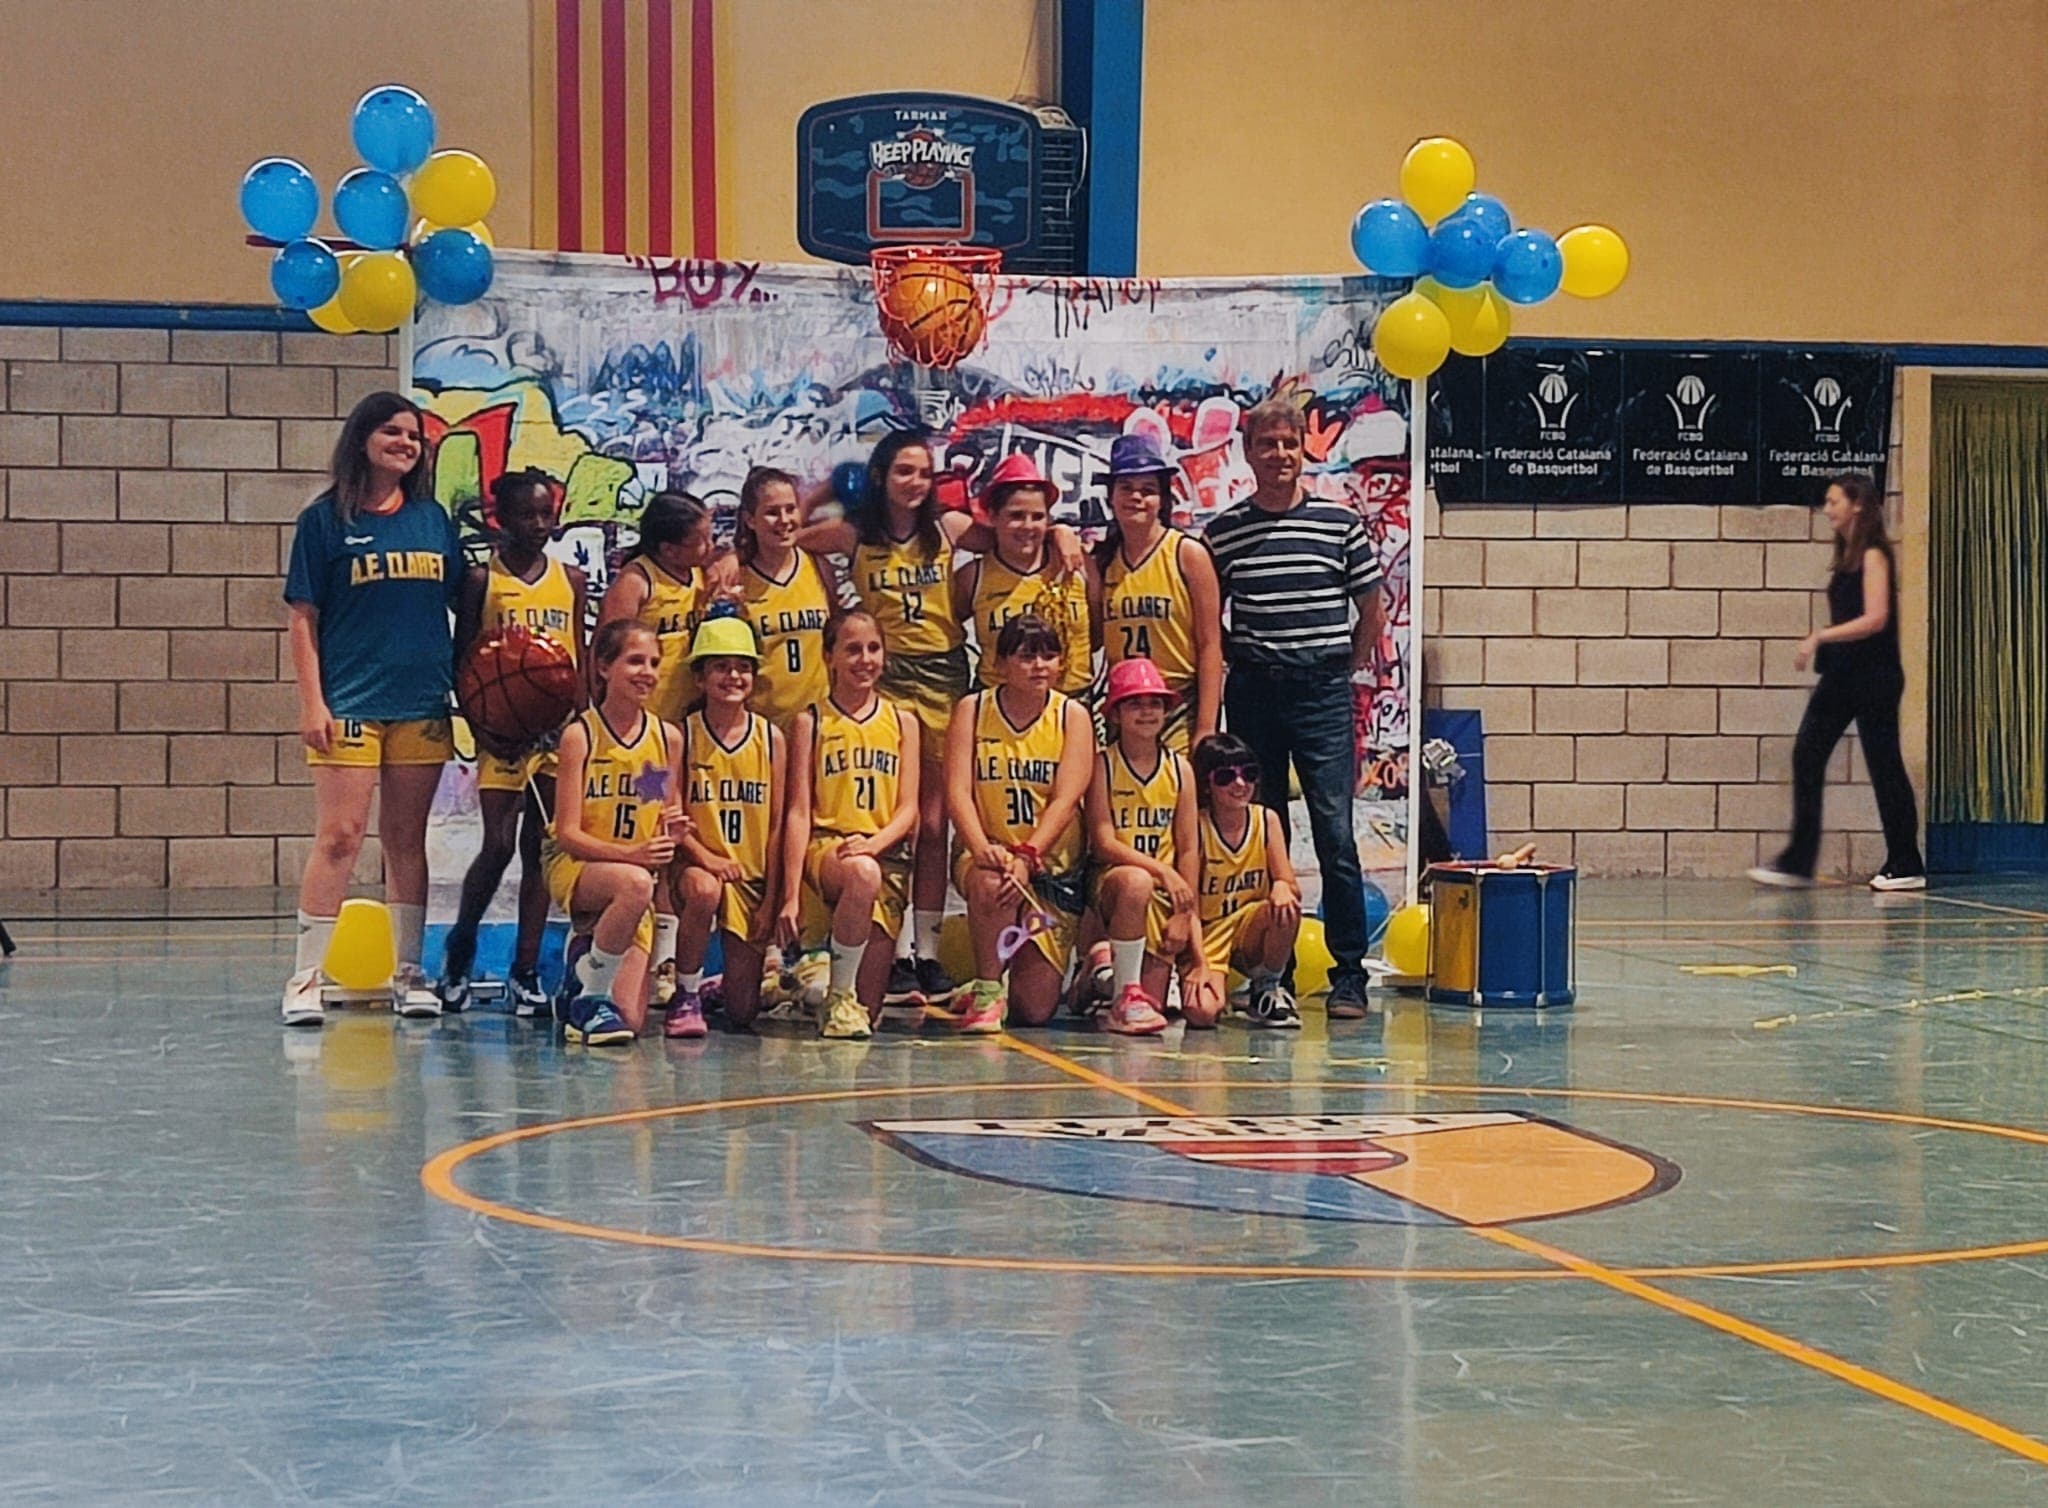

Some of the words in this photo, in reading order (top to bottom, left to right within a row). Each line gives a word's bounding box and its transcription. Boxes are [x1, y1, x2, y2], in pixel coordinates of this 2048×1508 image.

[894, 110, 948, 121] TARMAK
[1494, 447, 1554, 461] Federació
[1556, 448, 1612, 461] Catalana
[1508, 463, 1524, 474] de
[1527, 462, 1598, 477] Basquetbol
[1632, 448, 1691, 462] Federació
[1694, 448, 1748, 462] Catalana
[1768, 449, 1829, 463] Federació
[1831, 450, 1886, 463] Catalana
[1646, 464, 1662, 476] de
[1664, 464, 1735, 478] Basquetbol
[1781, 465, 1798, 477] de
[386, 551, 444, 582] CLARET
[902, 591, 926, 624] 12
[1122, 596, 1172, 621] CLARET
[786, 638, 801, 673] 8
[1120, 624, 1152, 658] 24
[853, 746, 898, 777] CLARET
[854, 775, 875, 811] 21
[1005, 787, 1034, 826] 30
[613, 802, 638, 840] 15
[719, 808, 742, 845] 18
